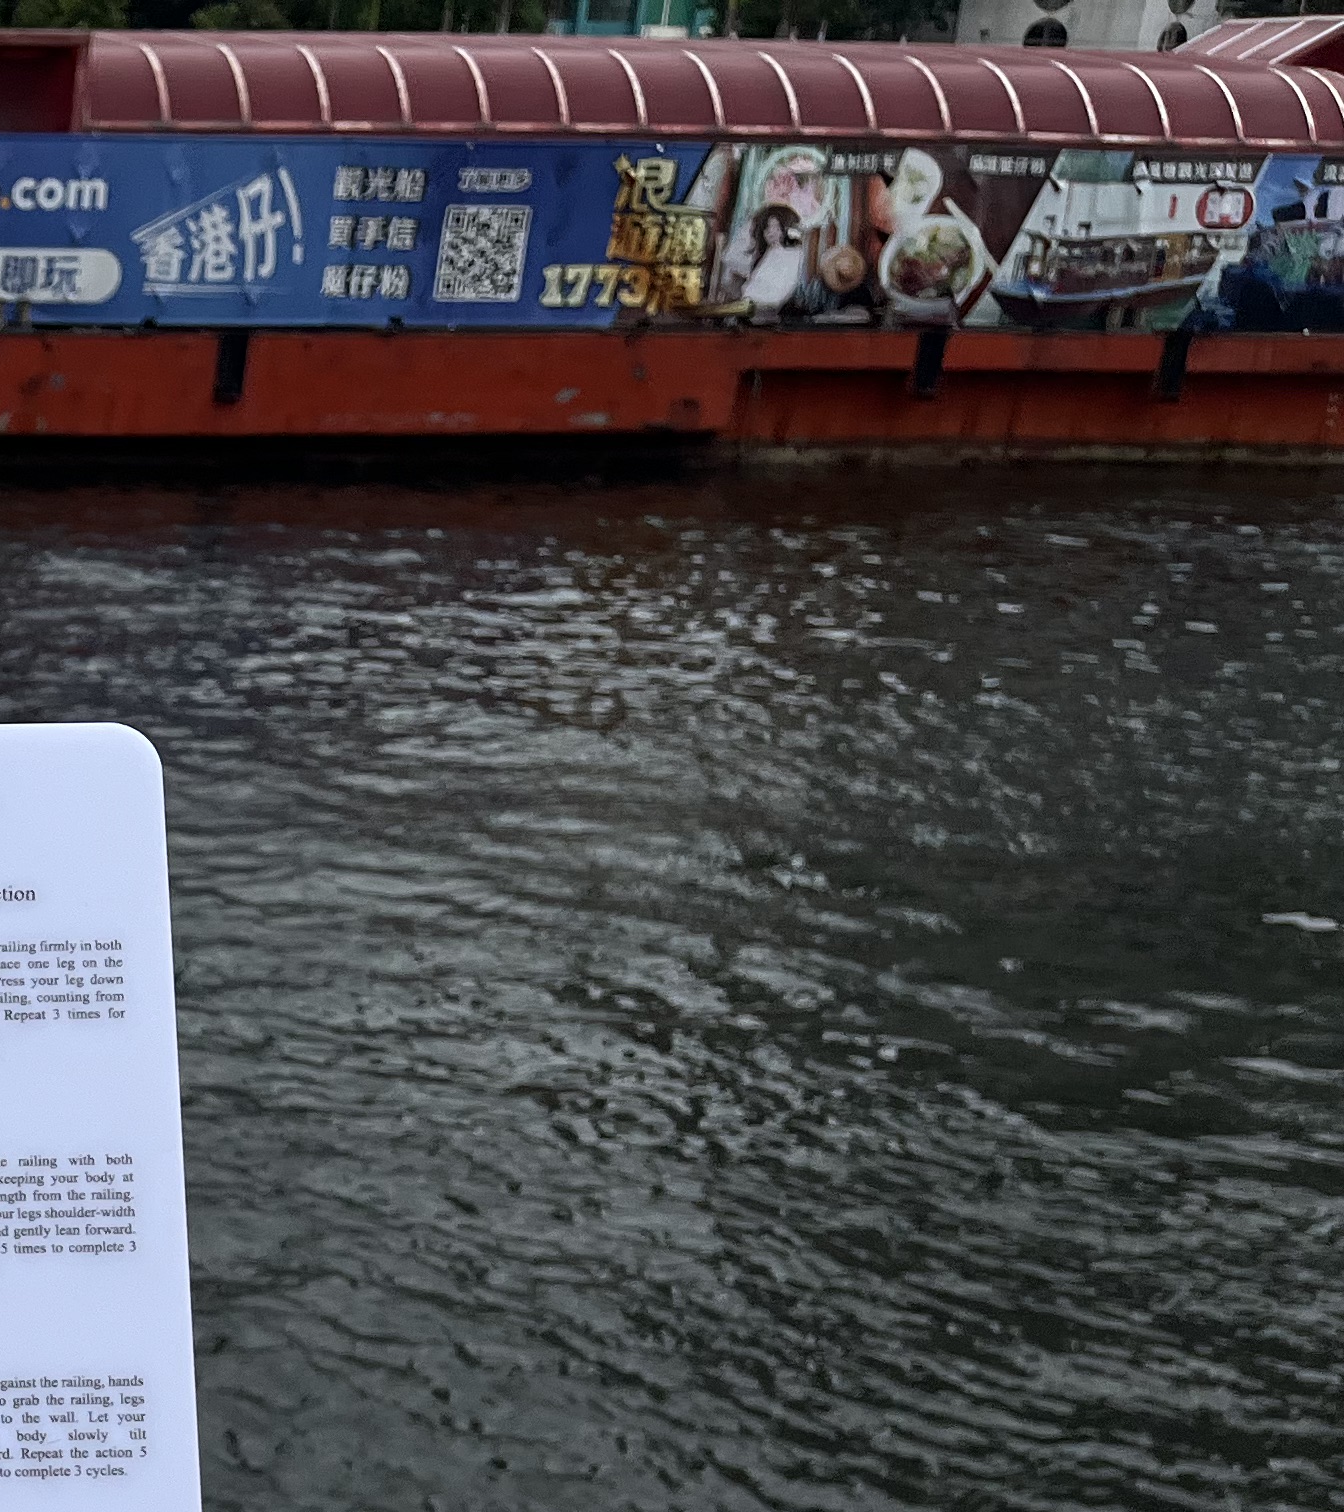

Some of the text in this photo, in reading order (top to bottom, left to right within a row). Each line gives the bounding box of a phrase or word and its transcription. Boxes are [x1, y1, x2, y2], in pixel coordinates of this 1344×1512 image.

[30, 977, 60, 990] your
[64, 973, 85, 989] leg
[89, 973, 124, 986] down
[18, 1154, 58, 1170] railing
[67, 1153, 96, 1166] with
[104, 1153, 134, 1166] both
[0, 1413, 14, 1425] to
[21, 1411, 41, 1424] the
[48, 1410, 79, 1424] wall.
[87, 1410, 110, 1423] Let
[116, 1413, 147, 1426] your
